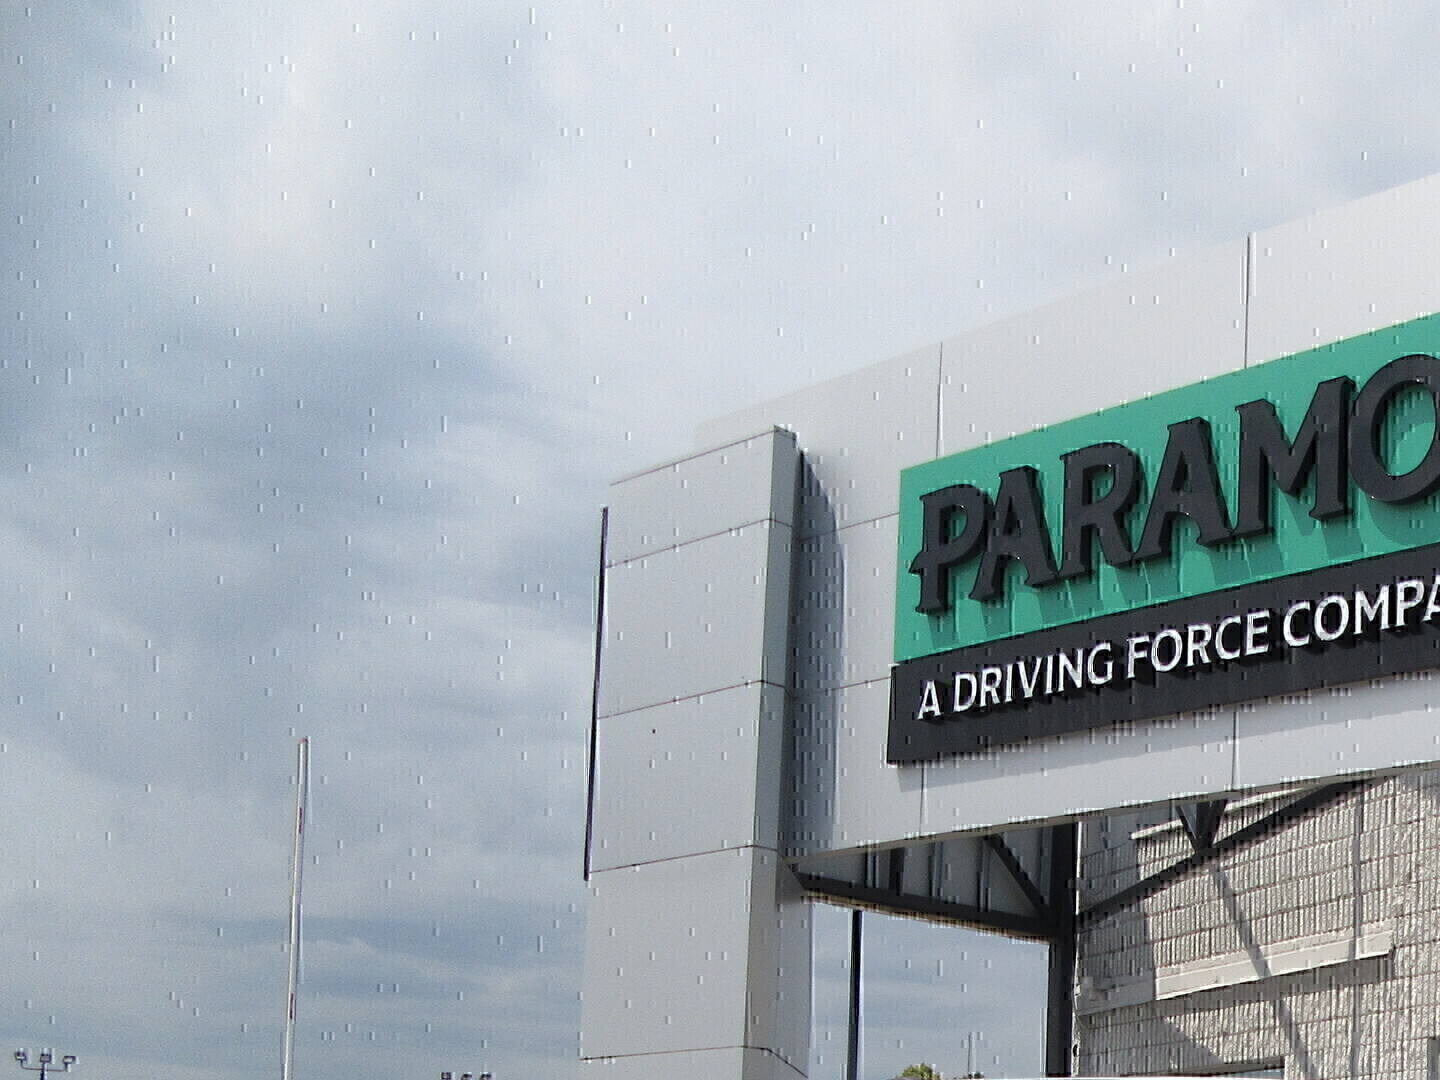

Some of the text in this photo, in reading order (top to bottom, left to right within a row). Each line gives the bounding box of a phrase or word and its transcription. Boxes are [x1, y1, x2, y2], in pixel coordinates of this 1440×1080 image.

[916, 680, 942, 720] A
[952, 642, 1115, 713] DRIVING
[1126, 609, 1270, 679] FORCE
